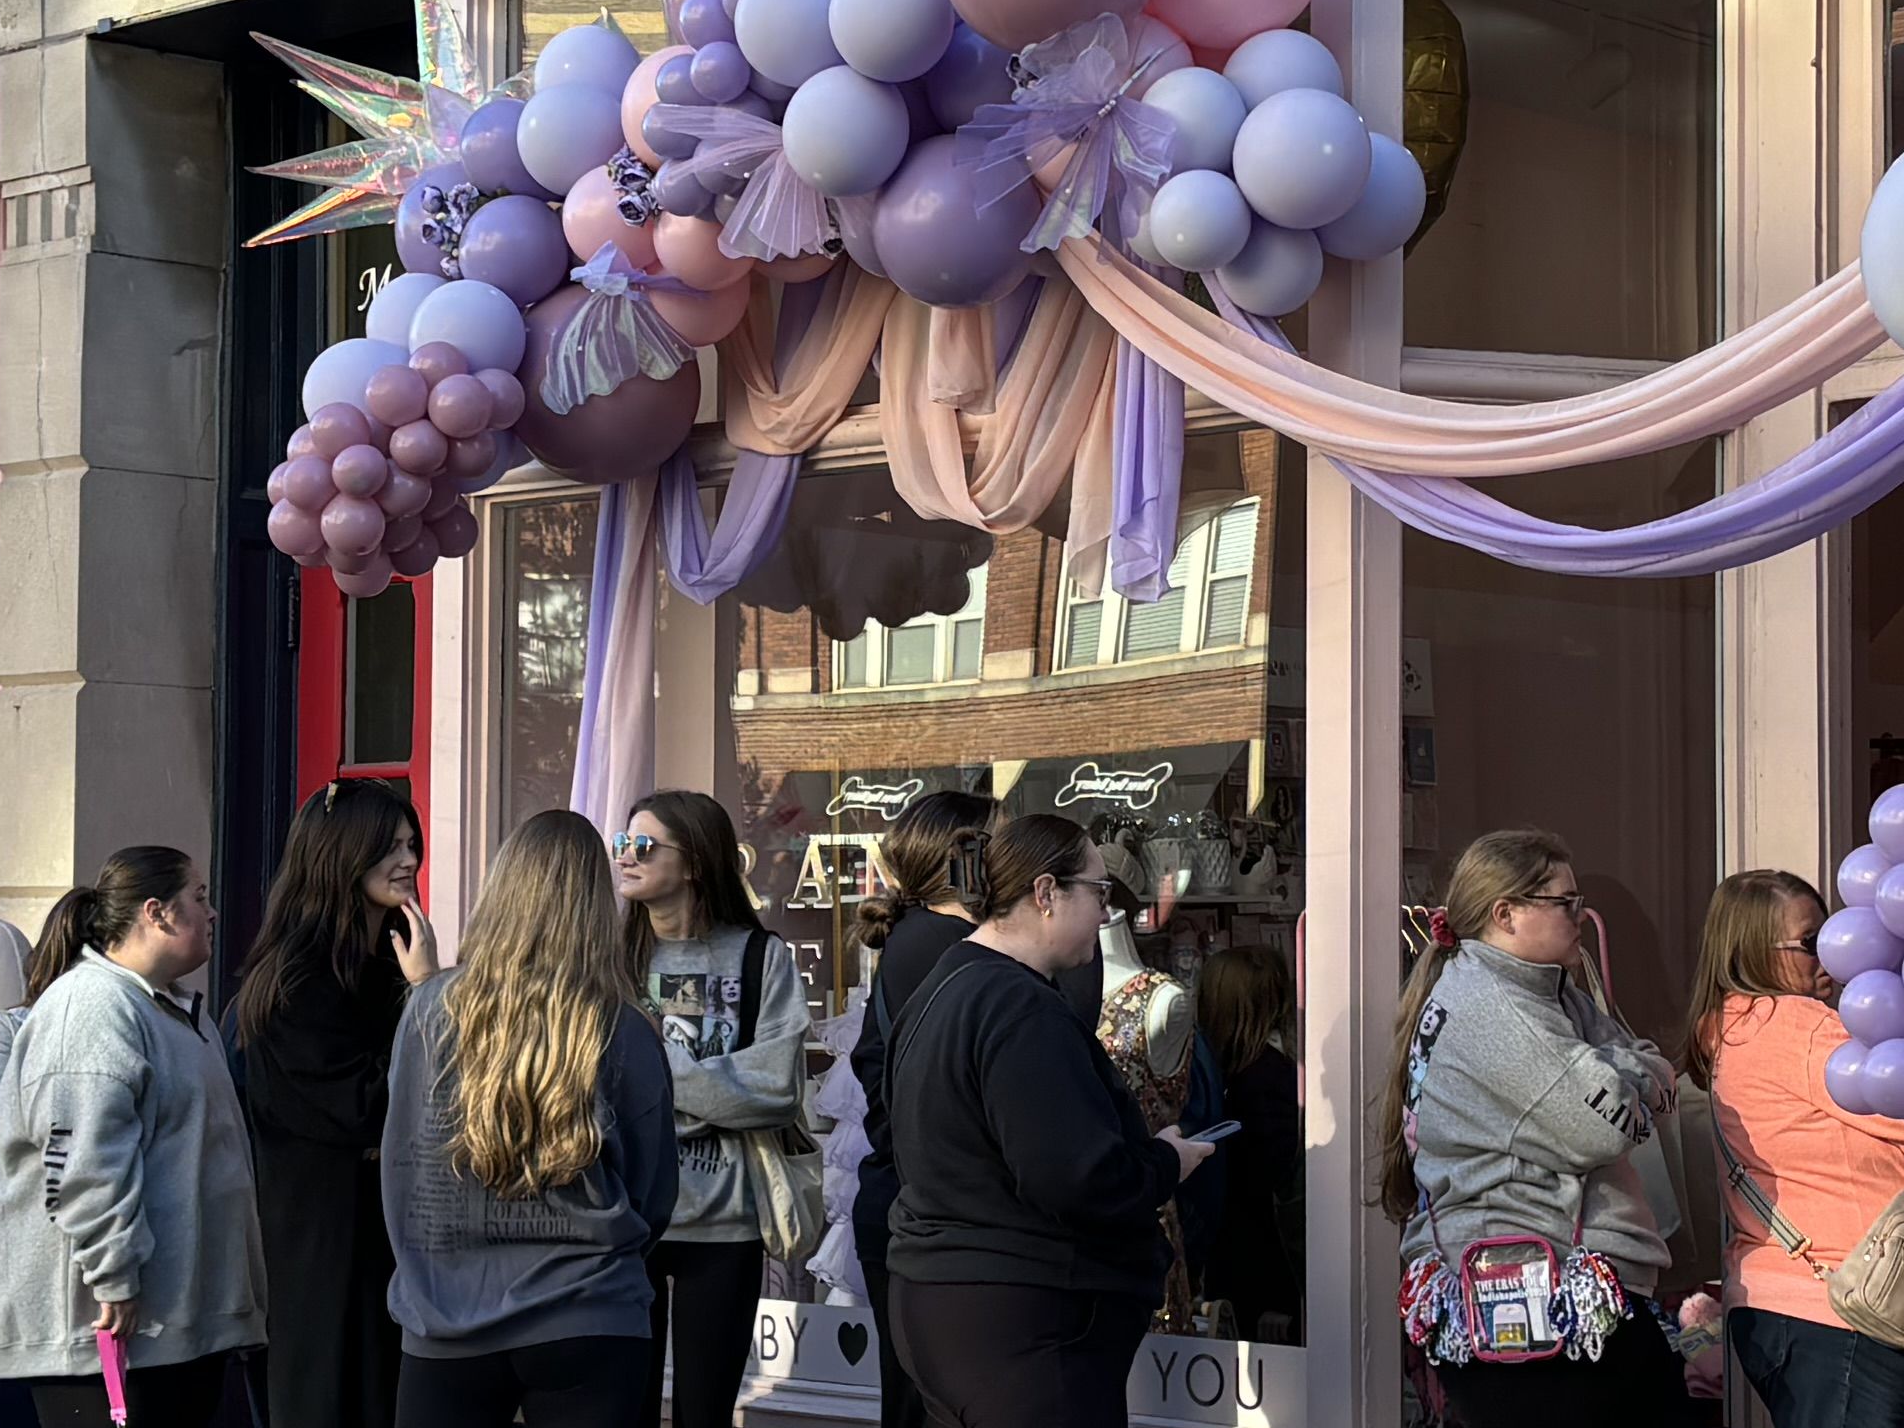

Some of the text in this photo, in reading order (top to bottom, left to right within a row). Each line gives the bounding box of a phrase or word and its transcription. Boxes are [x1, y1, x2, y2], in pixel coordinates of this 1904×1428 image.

[1475, 1280, 1494, 1292] THE
[1496, 1276, 1520, 1290] ERAS
[1151, 1350, 1264, 1411] YOU
